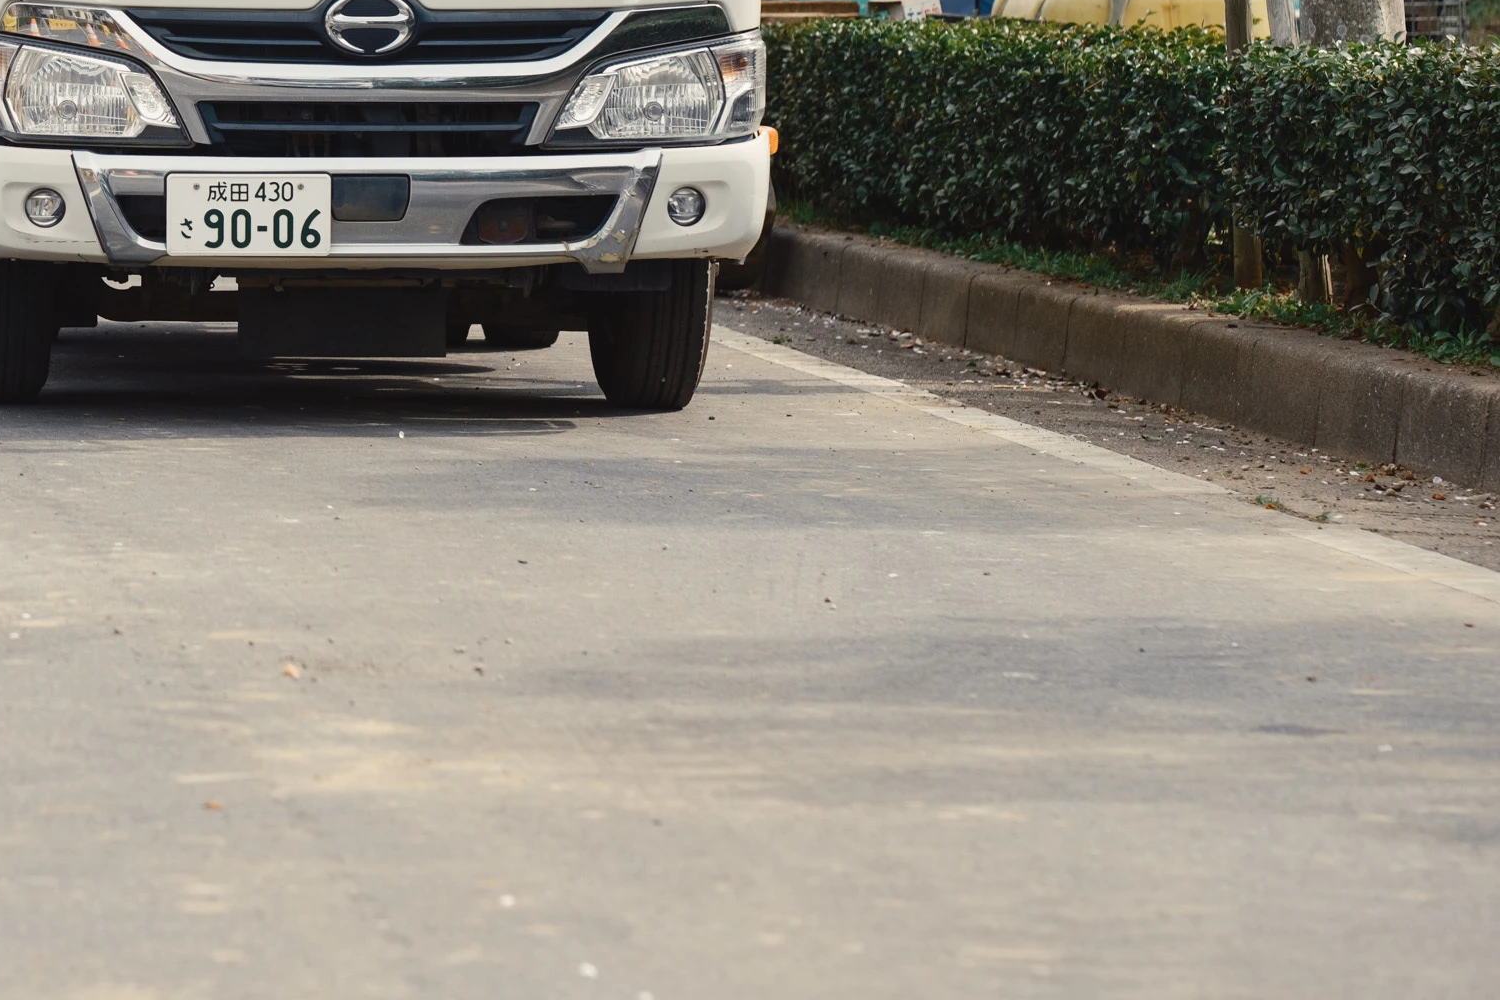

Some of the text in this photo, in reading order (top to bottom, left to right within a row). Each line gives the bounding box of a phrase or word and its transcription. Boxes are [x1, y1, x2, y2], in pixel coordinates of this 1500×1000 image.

[207, 182, 294, 202] 成田 430
[180, 209, 321, 249] さ 90-06
